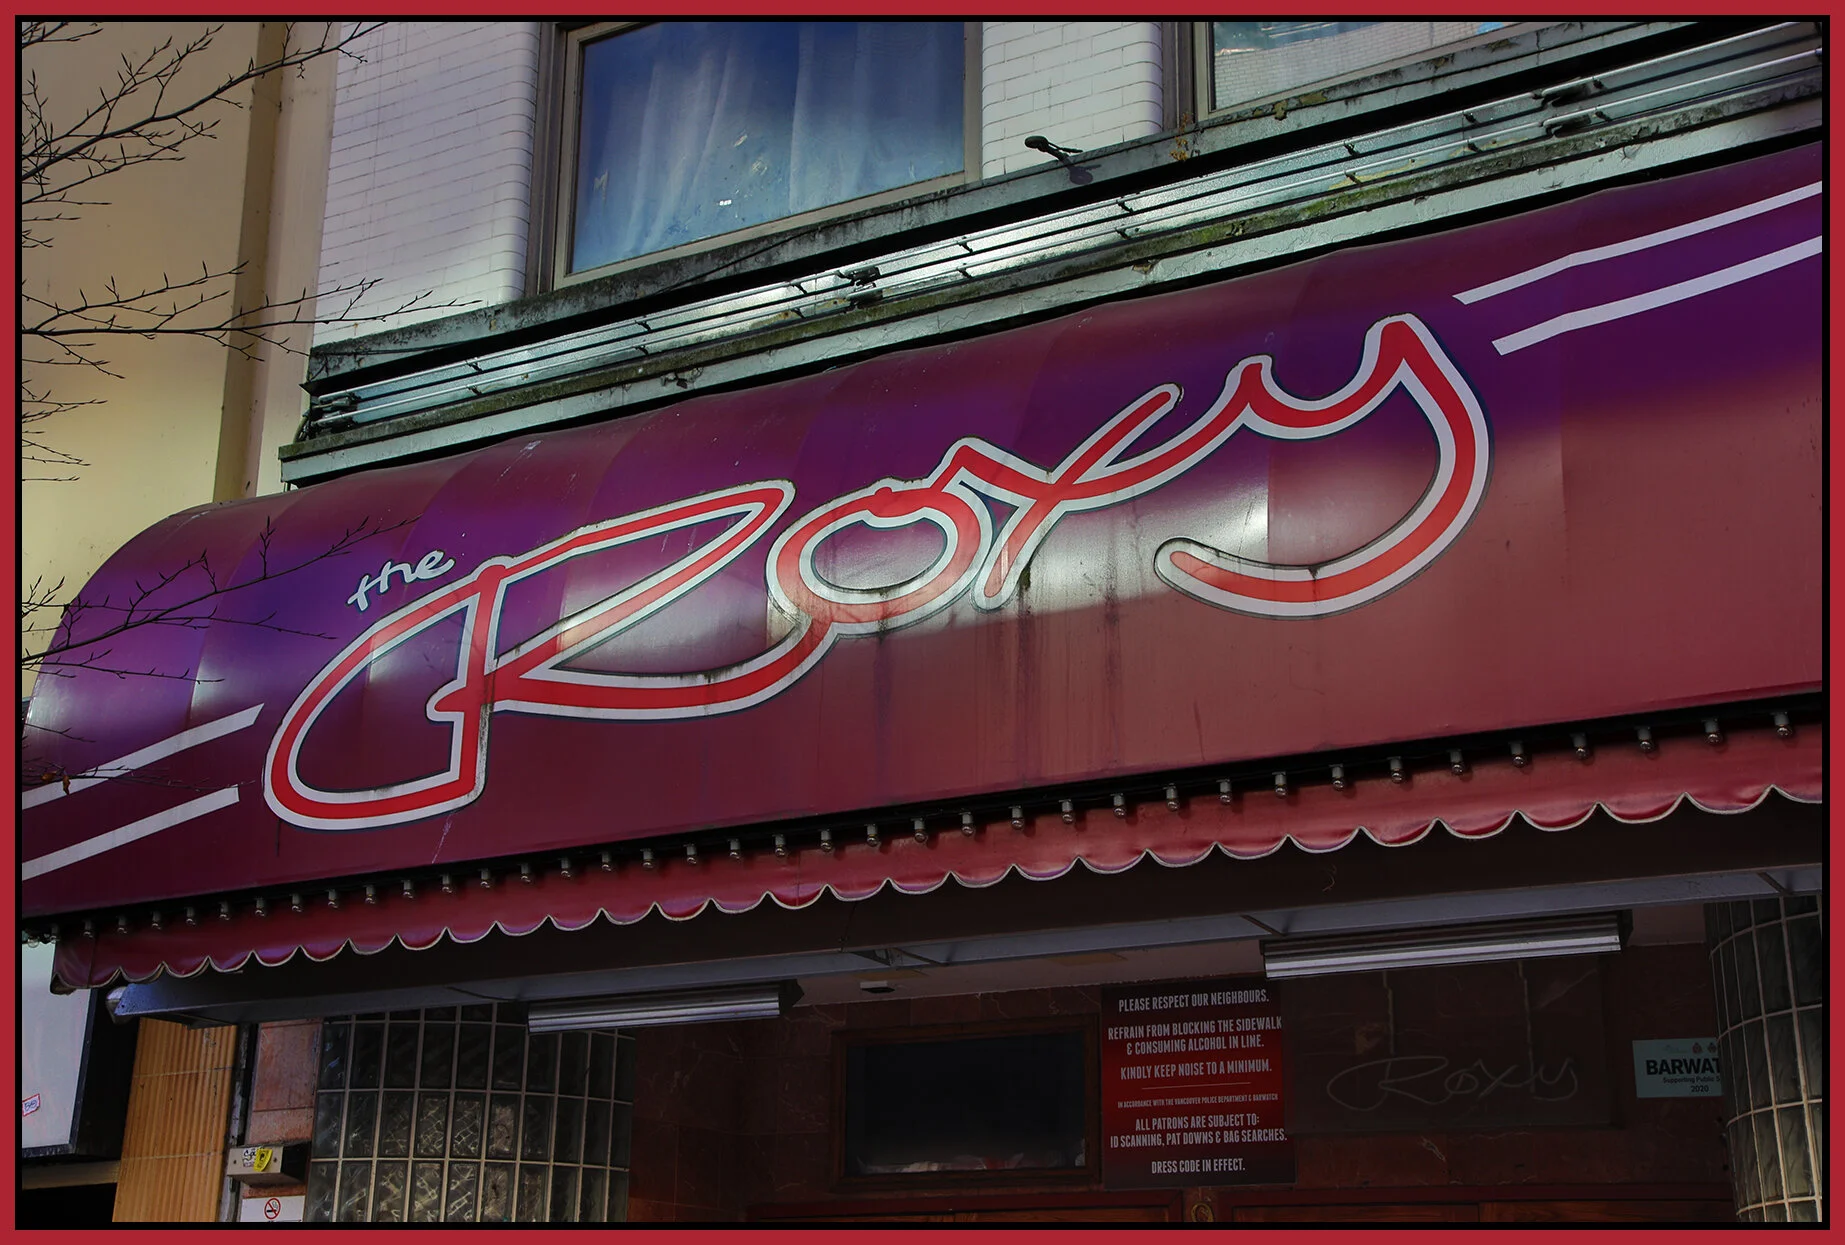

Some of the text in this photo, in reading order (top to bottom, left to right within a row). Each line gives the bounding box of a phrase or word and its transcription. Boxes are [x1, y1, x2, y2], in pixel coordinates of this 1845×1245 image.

[264, 312, 1492, 832] Roxy
[347, 549, 456, 612] the
[1119, 989, 1269, 1012] PLEASE RESPECT OUR NEIGHBOURS.
[1108, 1016, 1282, 1040] REFRAIN FROM BLOCKING THE SIDEWALK
[1135, 1039, 1186, 1055] CONSUMING
[1188, 1036, 1227, 1051] ALCOHOL
[1229, 1036, 1238, 1048] IN
[1241, 1034, 1264, 1048] LINE.
[1121, 1059, 1272, 1080] KINDLY KEEP NOISE TO A MINIMUM.
[1327, 1056, 1578, 1111] Roxy
[1123, 1099, 1152, 1108] ACCORDANCE
[1153, 1098, 1164, 1107] WITH
[1165, 1098, 1174, 1106] THE
[1175, 1096, 1201, 1106] VANCOUVER
[1201, 1096, 1217, 1104] POLICE
[1218, 1094, 1247, 1104] DEPARTMENT
[1253, 1093, 1278, 1101] BARWATCH
[1136, 1113, 1260, 1131] ALL PATRONS ARE SUBJECT TO:
[1110, 1136, 1118, 1148] ID
[1120, 1133, 1165, 1148] SCANNING,
[1166, 1132, 1181, 1145] PAT
[1183, 1131, 1213, 1144] DOWNS
[1224, 1130, 1239, 1143] BAG
[1241, 1128, 1287, 1142] SEARCHES.
[1152, 1158, 1245, 1174] DRESS CODE IN EFFECT.
